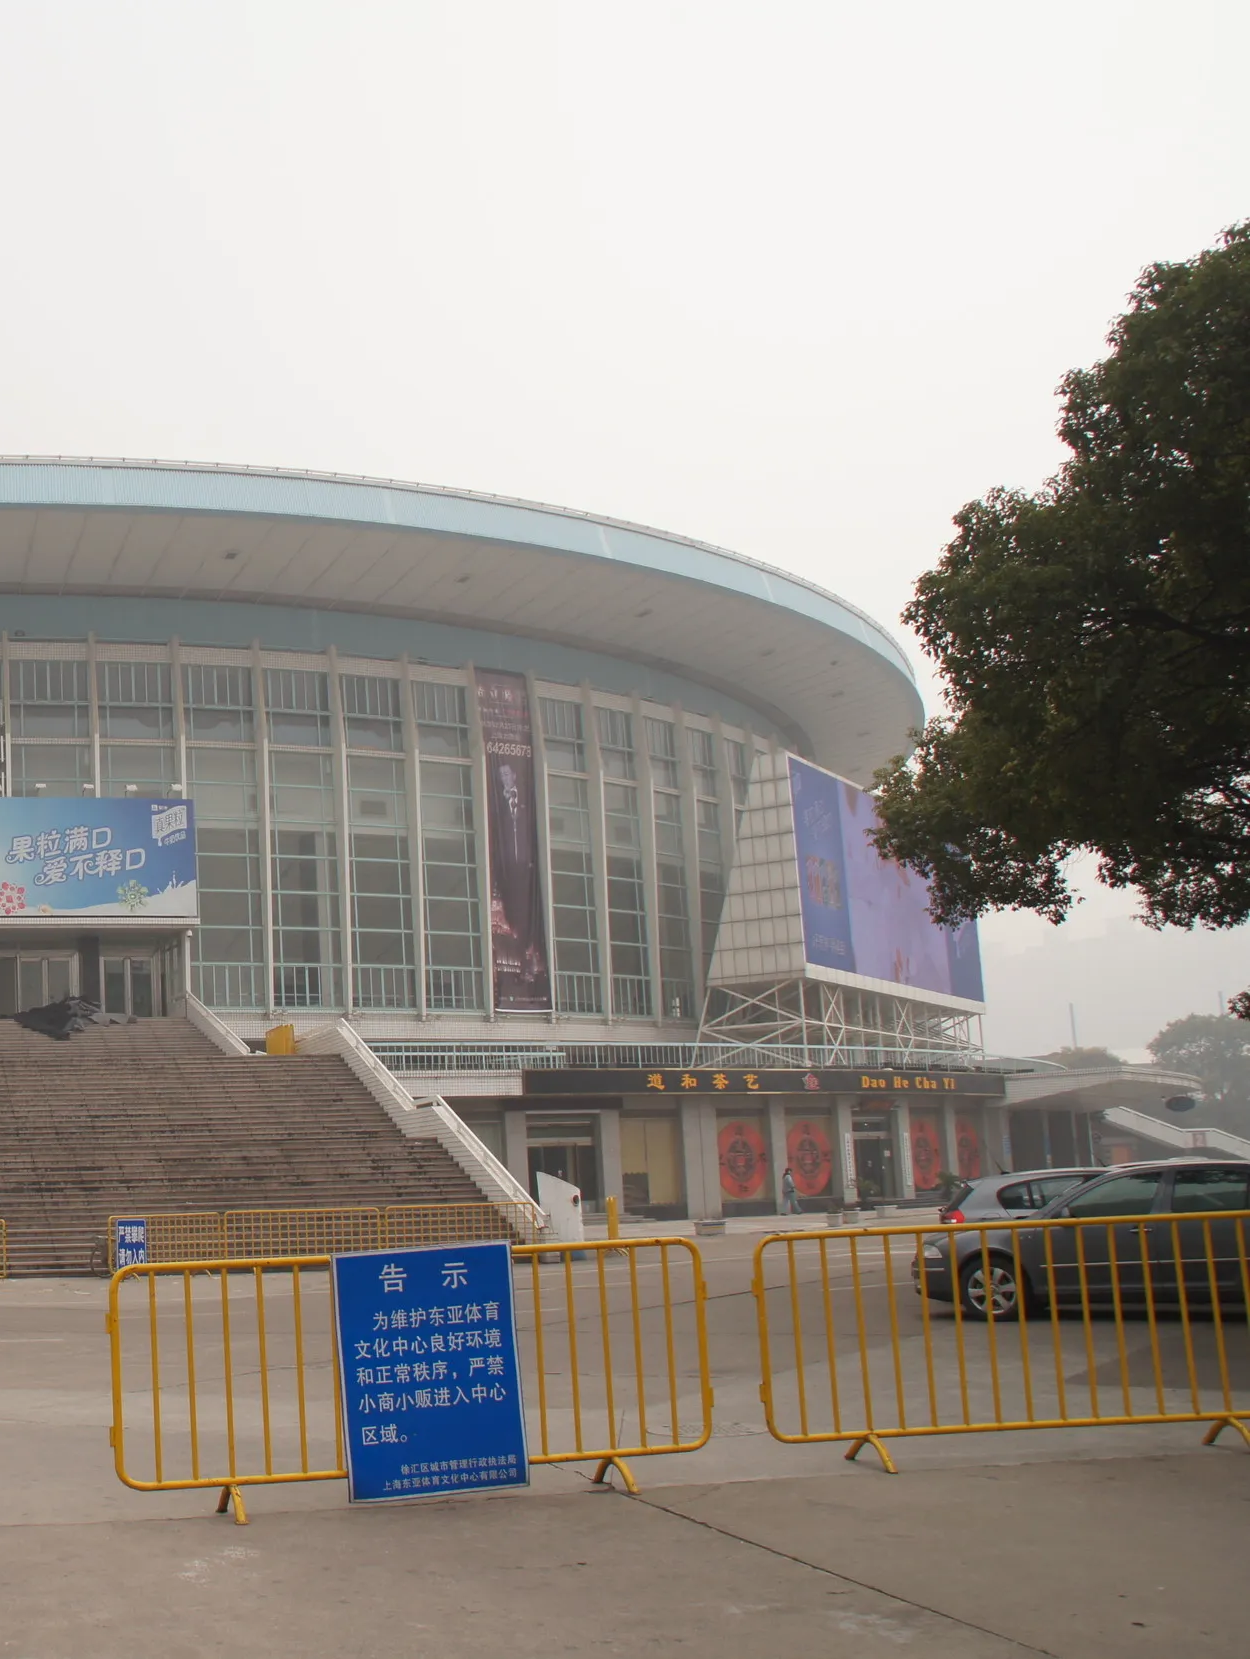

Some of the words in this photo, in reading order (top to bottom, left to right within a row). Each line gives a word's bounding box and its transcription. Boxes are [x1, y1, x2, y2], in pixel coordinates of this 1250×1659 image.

[5, 826, 112, 864] 果粒满口
[34, 848, 146, 886] 爱不释口
[647, 1073, 759, 1090] 道和茶艺
[862, 1075, 886, 1088] Dao
[893, 1076, 909, 1088] He
[915, 1077, 936, 1089] Cha
[118, 1226, 144, 1243] 严禁攀爬
[118, 1248, 145, 1264] 请勿入内
[379, 1262, 468, 1292] 告示
[373, 1301, 500, 1331] 为维护东亚体育
[354, 1328, 502, 1360] 文化中心良好环境
[357, 1356, 504, 1387] 和正常秩序，严禁
[359, 1382, 506, 1414] 小商小贩进入中心
[362, 1423, 408, 1446] 区域。
[401, 1454, 517, 1475] 徐汇区城市管理行政执法局
[383, 1468, 517, 1491] 上海东亚体育文化中心有限公司
